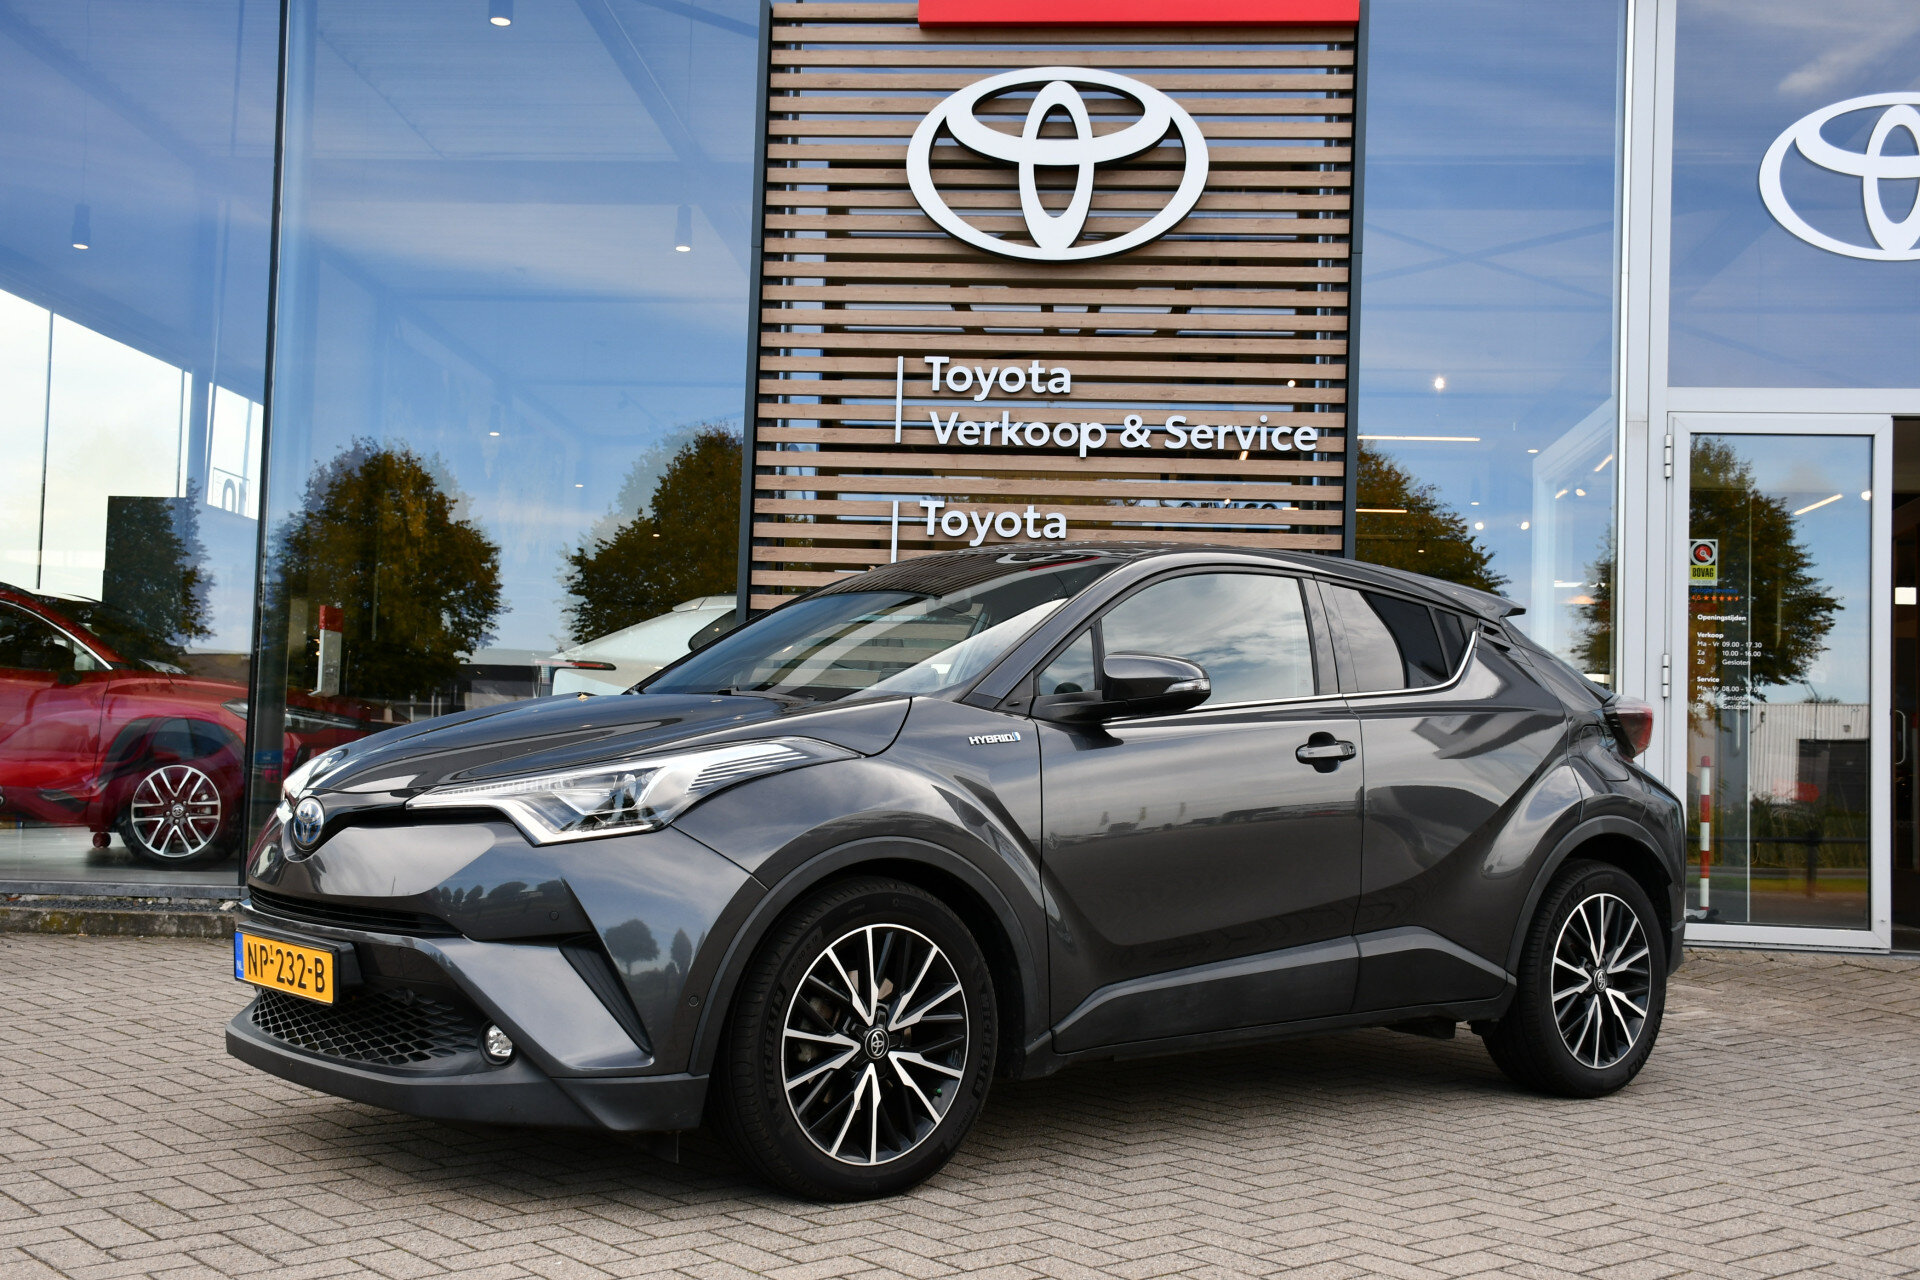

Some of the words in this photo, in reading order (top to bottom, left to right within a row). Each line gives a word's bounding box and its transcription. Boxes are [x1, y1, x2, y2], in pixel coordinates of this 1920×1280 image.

[924, 355, 1072, 402] Toyota
[929, 410, 1108, 458] Verkoop
[1119, 414, 1152, 449] &
[1164, 415, 1319, 452] Service
[919, 500, 1067, 547] Toyota
[1692, 567, 1714, 579] BOVAG
[1697, 614, 1747, 622] Openingstijden
[1696, 632, 1725, 640] Verkoop
[1745, 641, 1763, 649] 17.30
[1722, 658, 1751, 666] Gesloten
[968, 734, 1014, 745] HYBRID
[247, 941, 326, 994] NP-232-B
